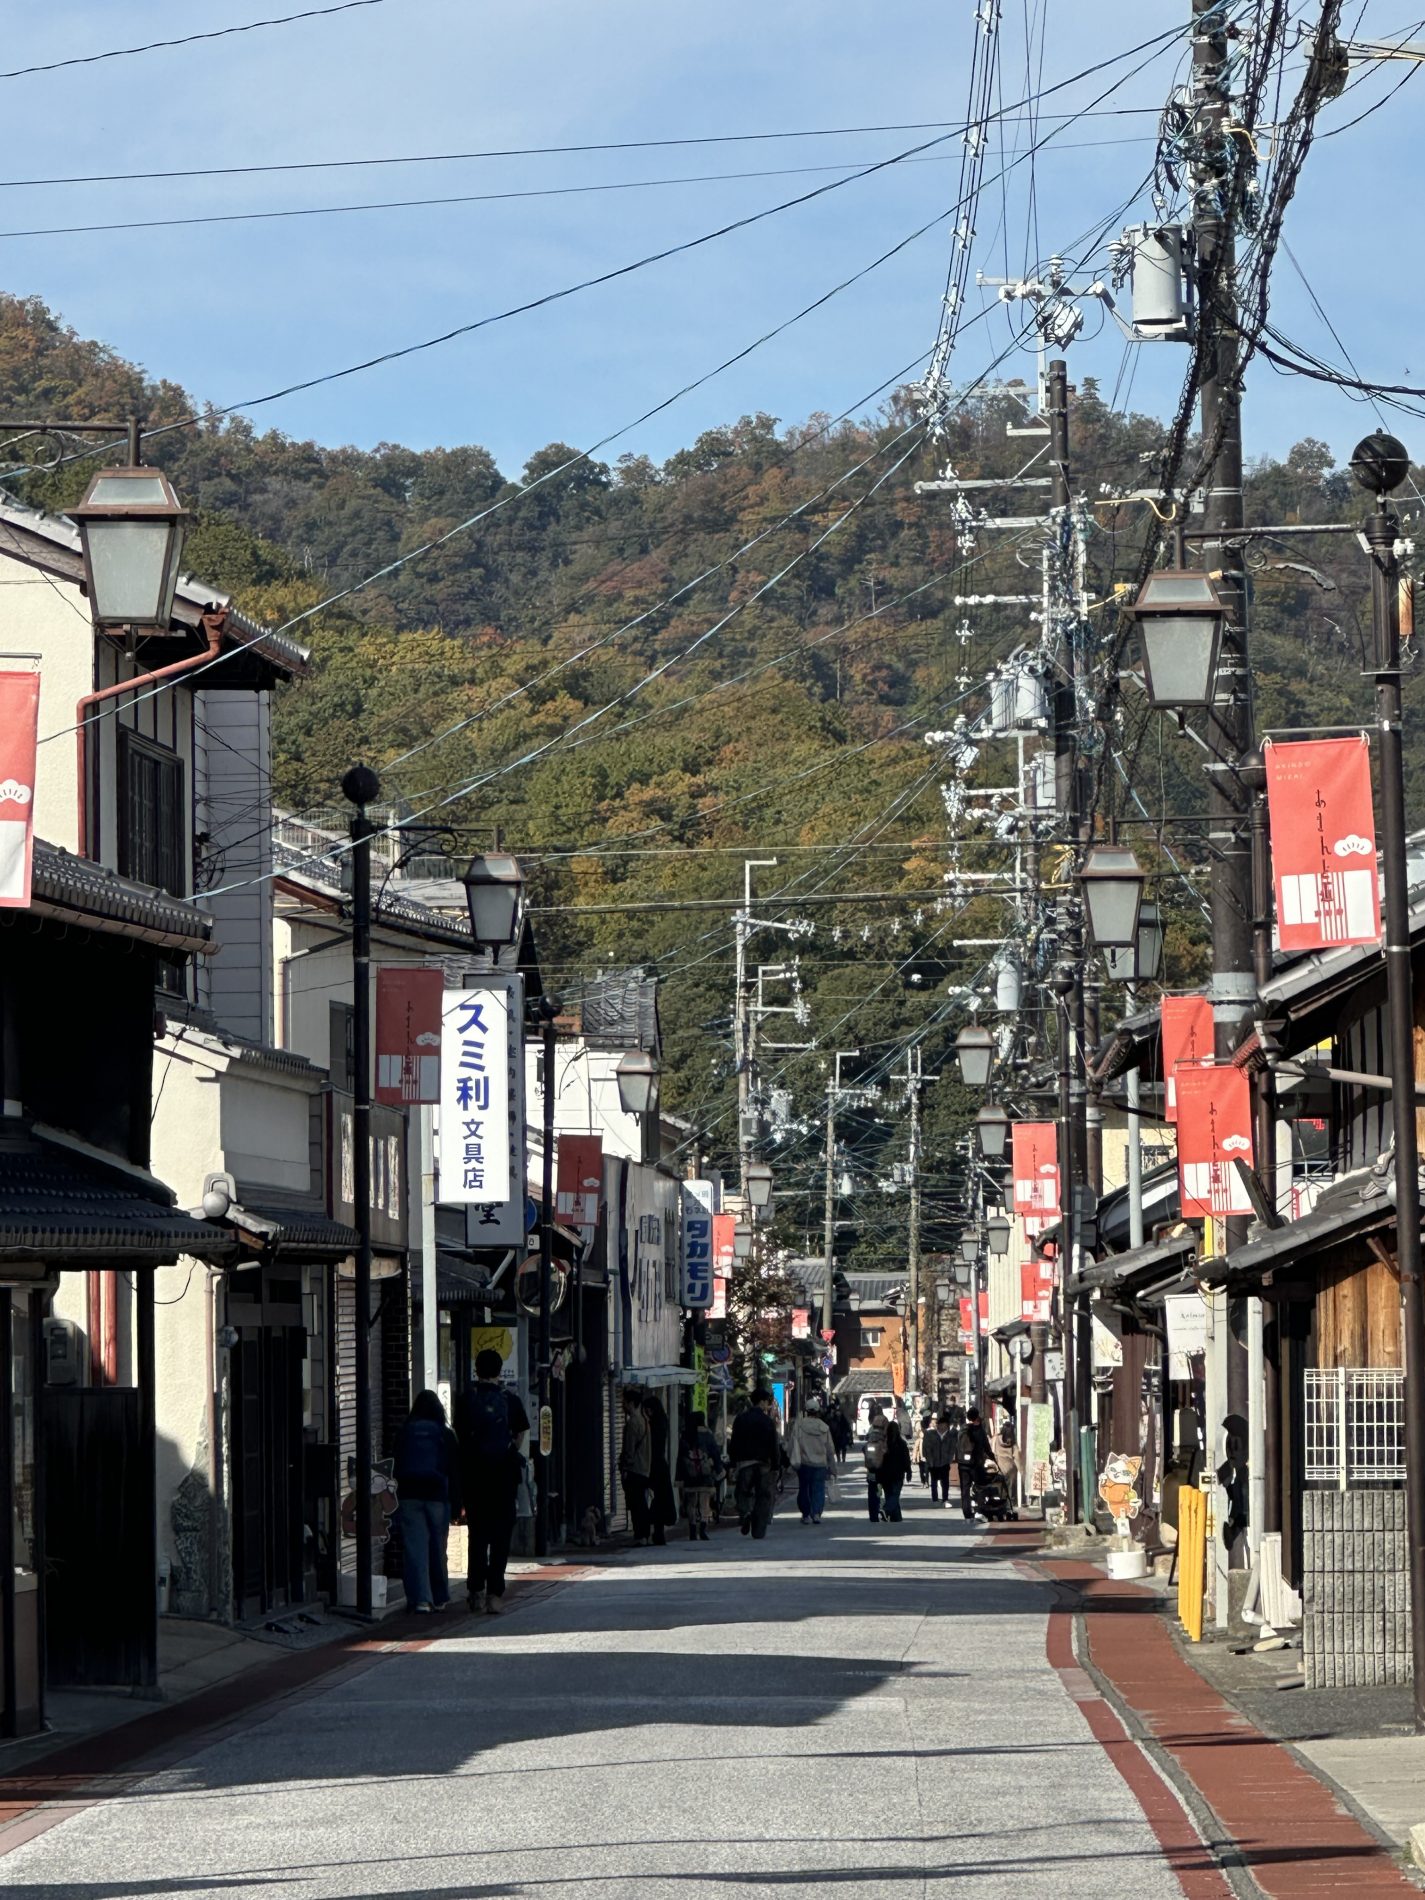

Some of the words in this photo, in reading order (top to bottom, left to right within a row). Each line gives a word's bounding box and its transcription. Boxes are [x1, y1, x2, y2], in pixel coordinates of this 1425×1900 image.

[456, 1003, 489, 1190] スミ利文具店
[686, 1220, 709, 1301] タカモリ
